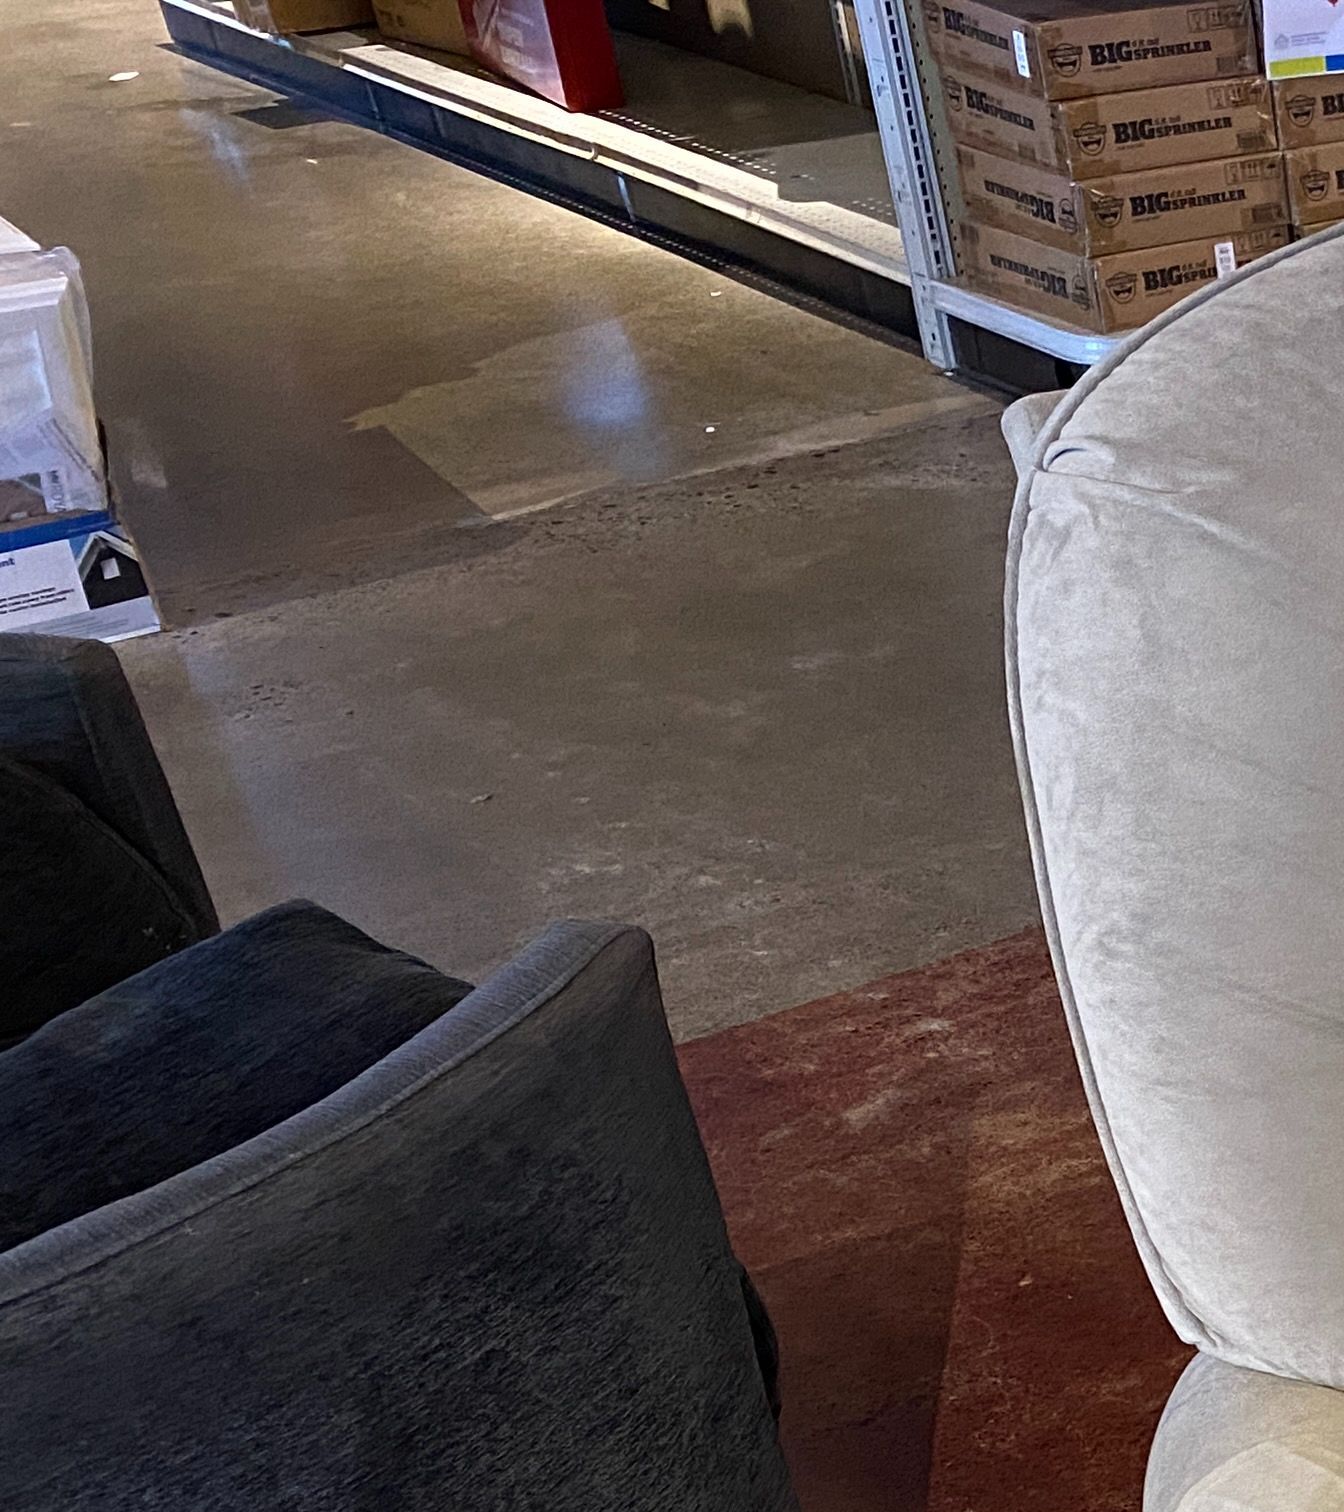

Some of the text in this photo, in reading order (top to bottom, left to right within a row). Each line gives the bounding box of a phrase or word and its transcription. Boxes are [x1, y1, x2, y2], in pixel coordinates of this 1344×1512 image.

[1088, 39, 1212, 66] BIG SPRINKLER
[1112, 116, 1232, 144] BIG SPRINKLER
[1129, 189, 1246, 217] BIG SPRINKLER
[1142, 265, 1183, 292] BIG
